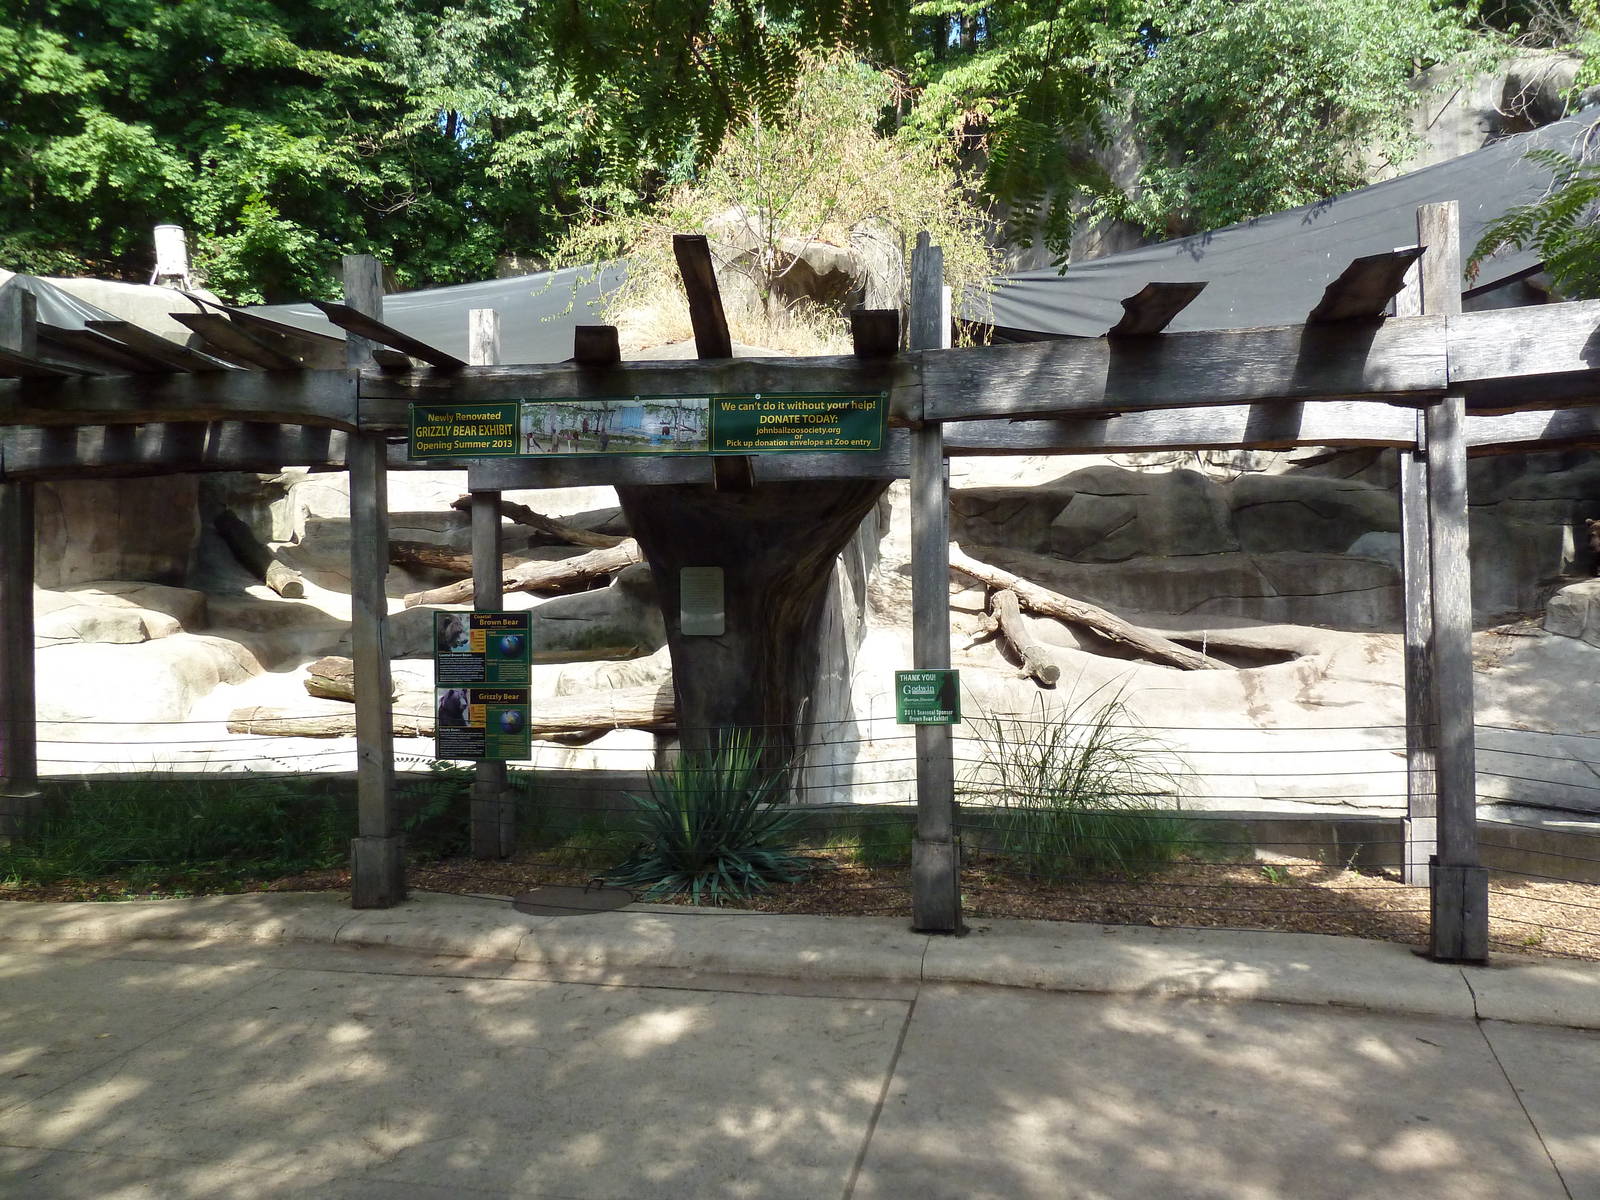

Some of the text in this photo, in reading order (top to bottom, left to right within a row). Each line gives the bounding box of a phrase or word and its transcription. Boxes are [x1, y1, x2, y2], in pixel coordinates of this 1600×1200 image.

[721, 400, 876, 413] We can't do it without your help!
[428, 411, 502, 423] Newly Renovated
[759, 414, 838, 424] DONATE TODAY:
[415, 424, 513, 437] GRIZZLY BEAR EXHIBIT
[756, 426, 841, 435] johnballzoosociety.org
[416, 439, 513, 451] Opening Summer 2013
[726, 439, 742, 447] Pick
[743, 440, 753, 448] up
[789, 439, 824, 447] envelope
[834, 438, 849, 446] Zoo
[850, 439, 871, 447] entry
[900, 673, 937, 682] THANK YOU!
[903, 684, 935, 695] Godwin
[478, 693, 503, 701] Grizzly
